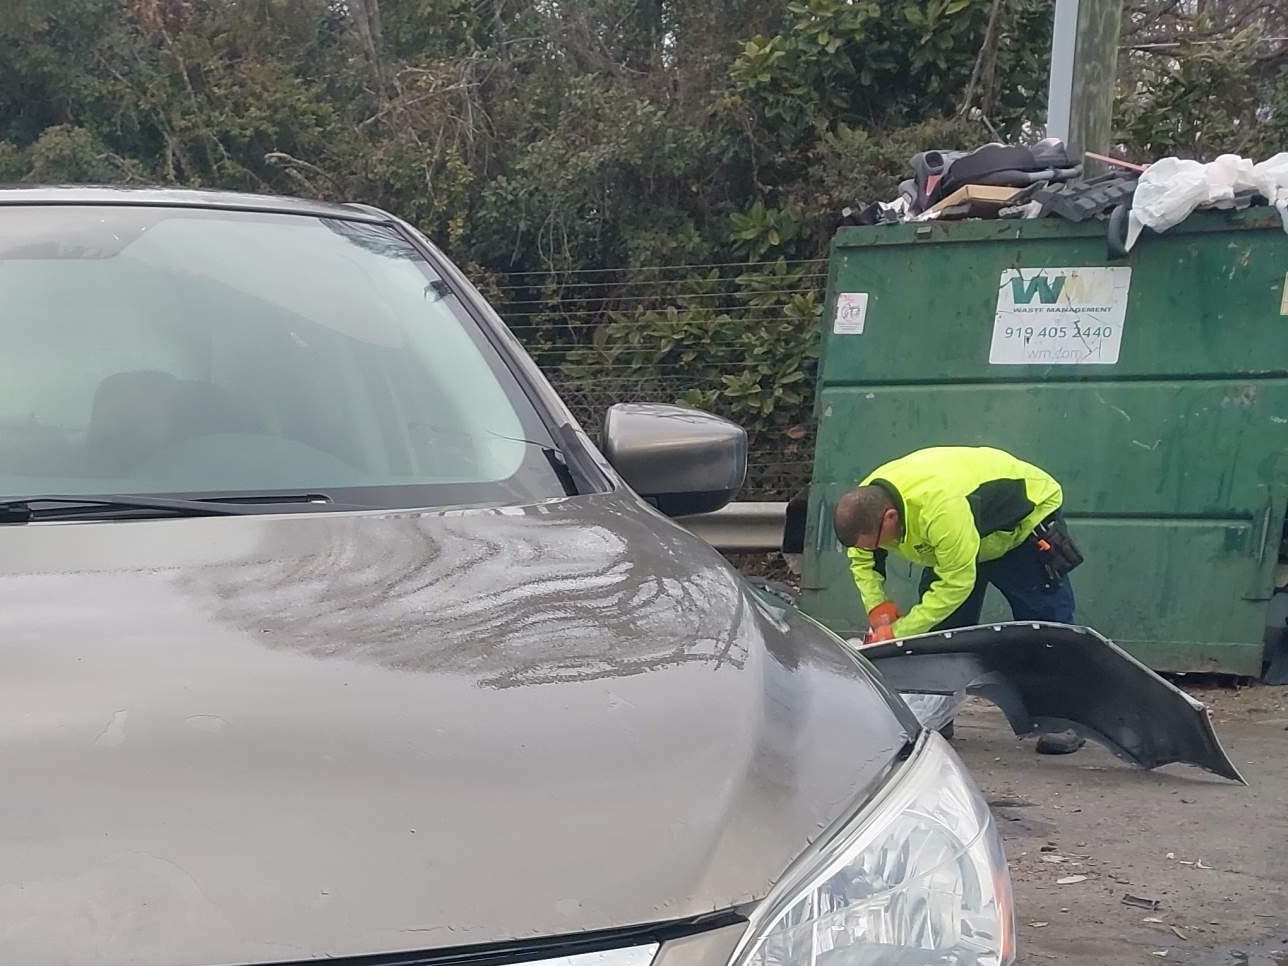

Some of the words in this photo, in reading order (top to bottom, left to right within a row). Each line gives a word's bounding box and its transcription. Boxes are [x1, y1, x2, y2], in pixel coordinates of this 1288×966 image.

[1004, 326, 1034, 338] 919
[1037, 326, 1067, 338] 405
[1071, 326, 1112, 338] 2440
